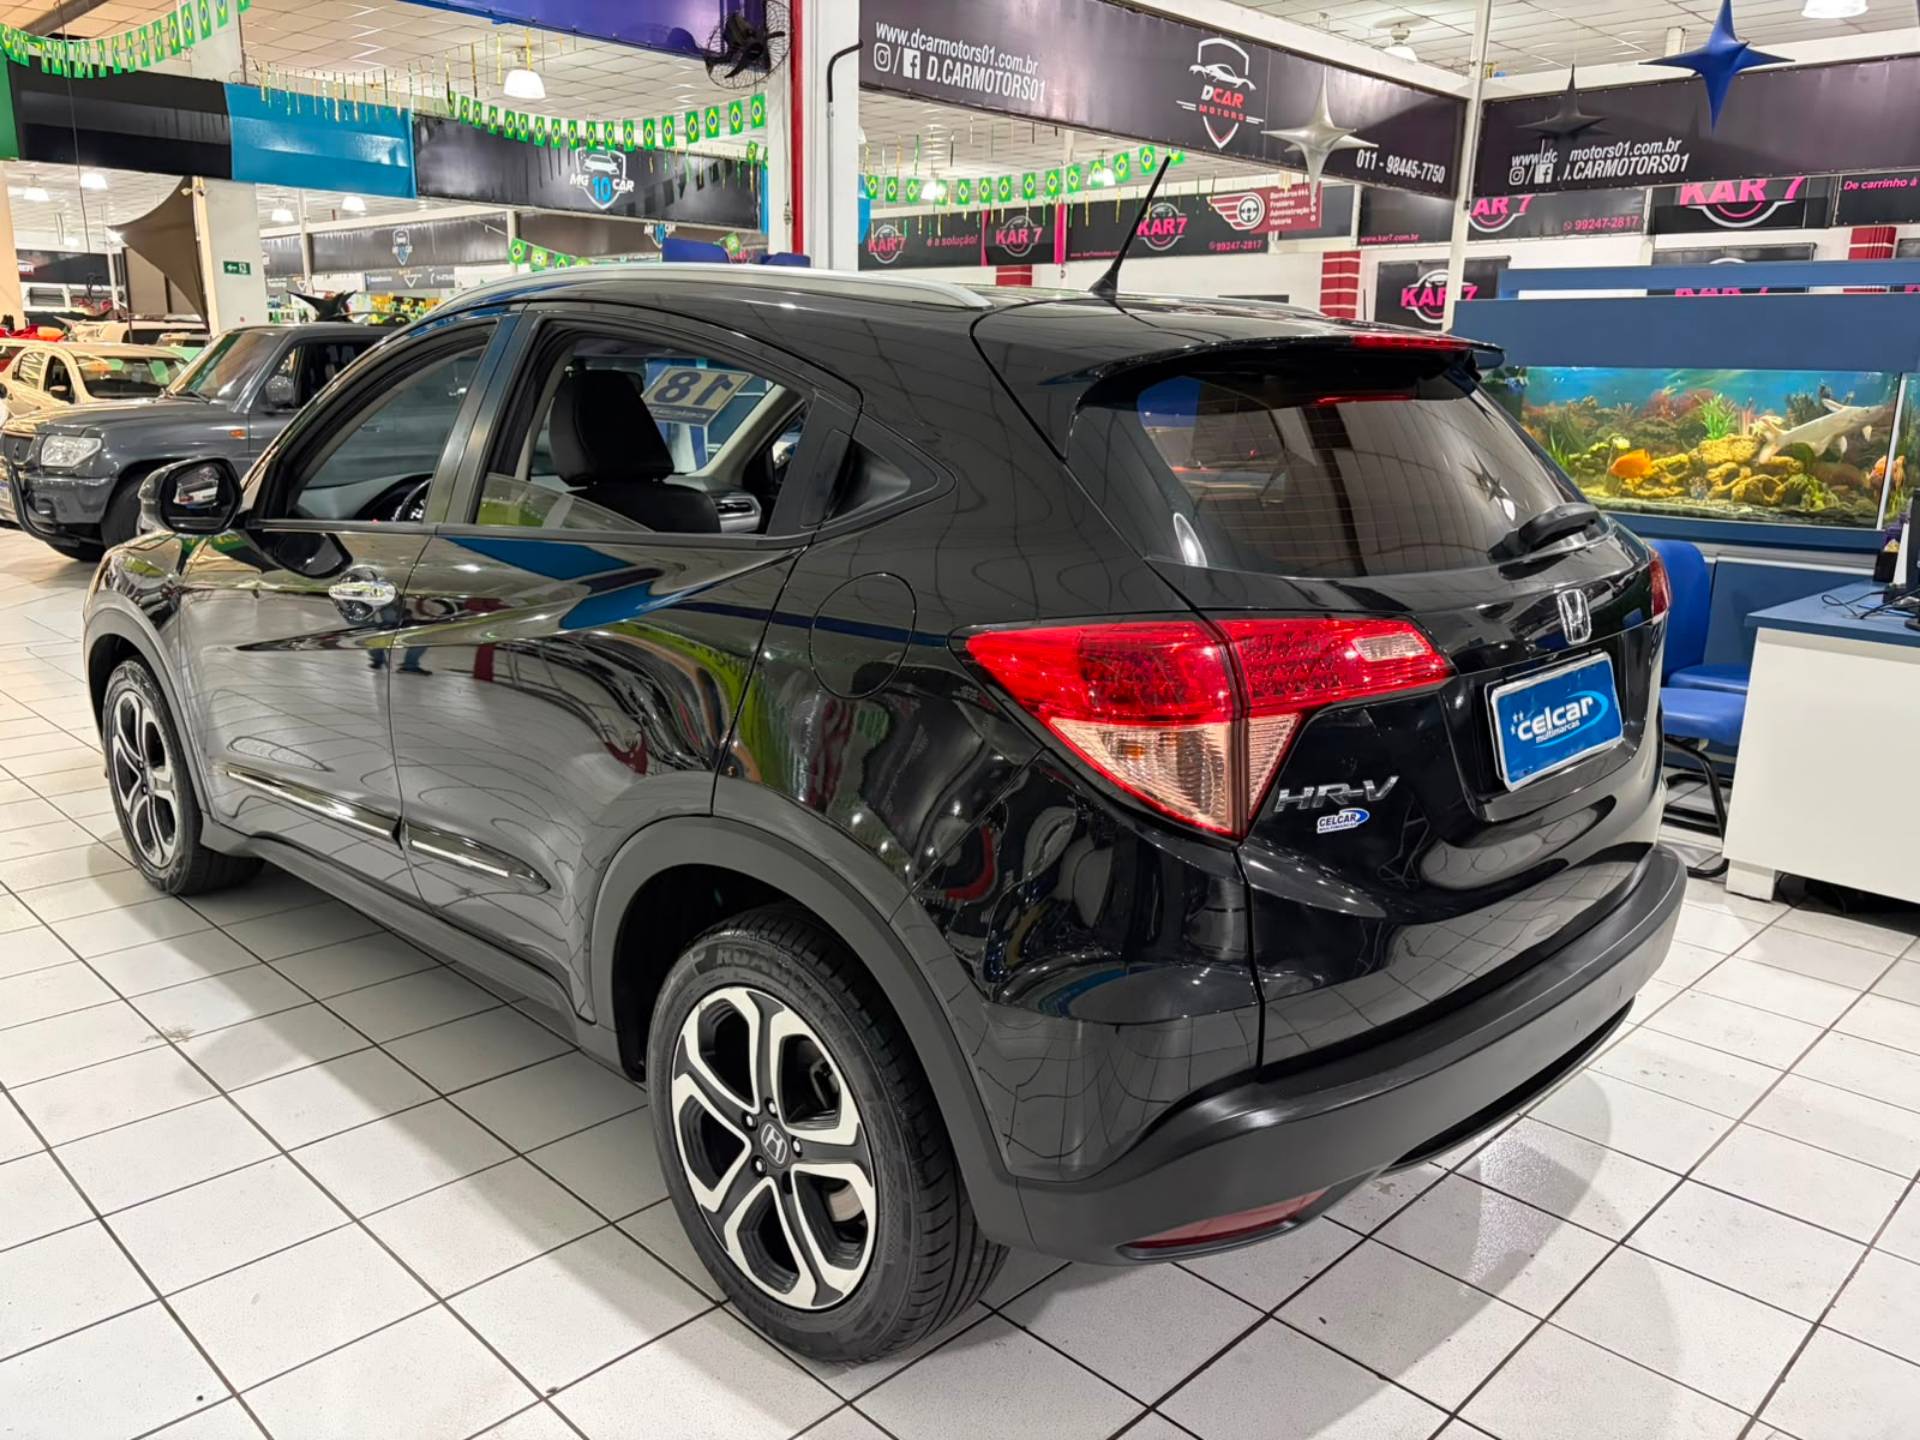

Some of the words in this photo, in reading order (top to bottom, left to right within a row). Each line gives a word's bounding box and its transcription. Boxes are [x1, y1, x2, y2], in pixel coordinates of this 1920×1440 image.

[876, 22, 1039, 75] www.dcarmotors01.com.br
[926, 56, 1046, 101] D.CARMOTORS01
[1201, 84, 1245, 109] DCAR
[1199, 104, 1245, 121] MOTORS
[1356, 149, 1378, 171] 011
[1386, 155, 1446, 184] 98445-7750
[1511, 137, 1682, 167] www.dcmotors01.com.br
[569, 173, 589, 187] MG
[592, 176, 613, 202] 10
[612, 178, 635, 193] CAR
[1844, 181, 1859, 191] De
[1861, 178, 1908, 190] carrinho
[1471, 196, 1509, 217] AR
[1518, 696, 1595, 741] celcar
[1535, 720, 1581, 744] multimarcas
[1274, 776, 1400, 813] HR-V
[1319, 814, 1357, 828] CELCAR
